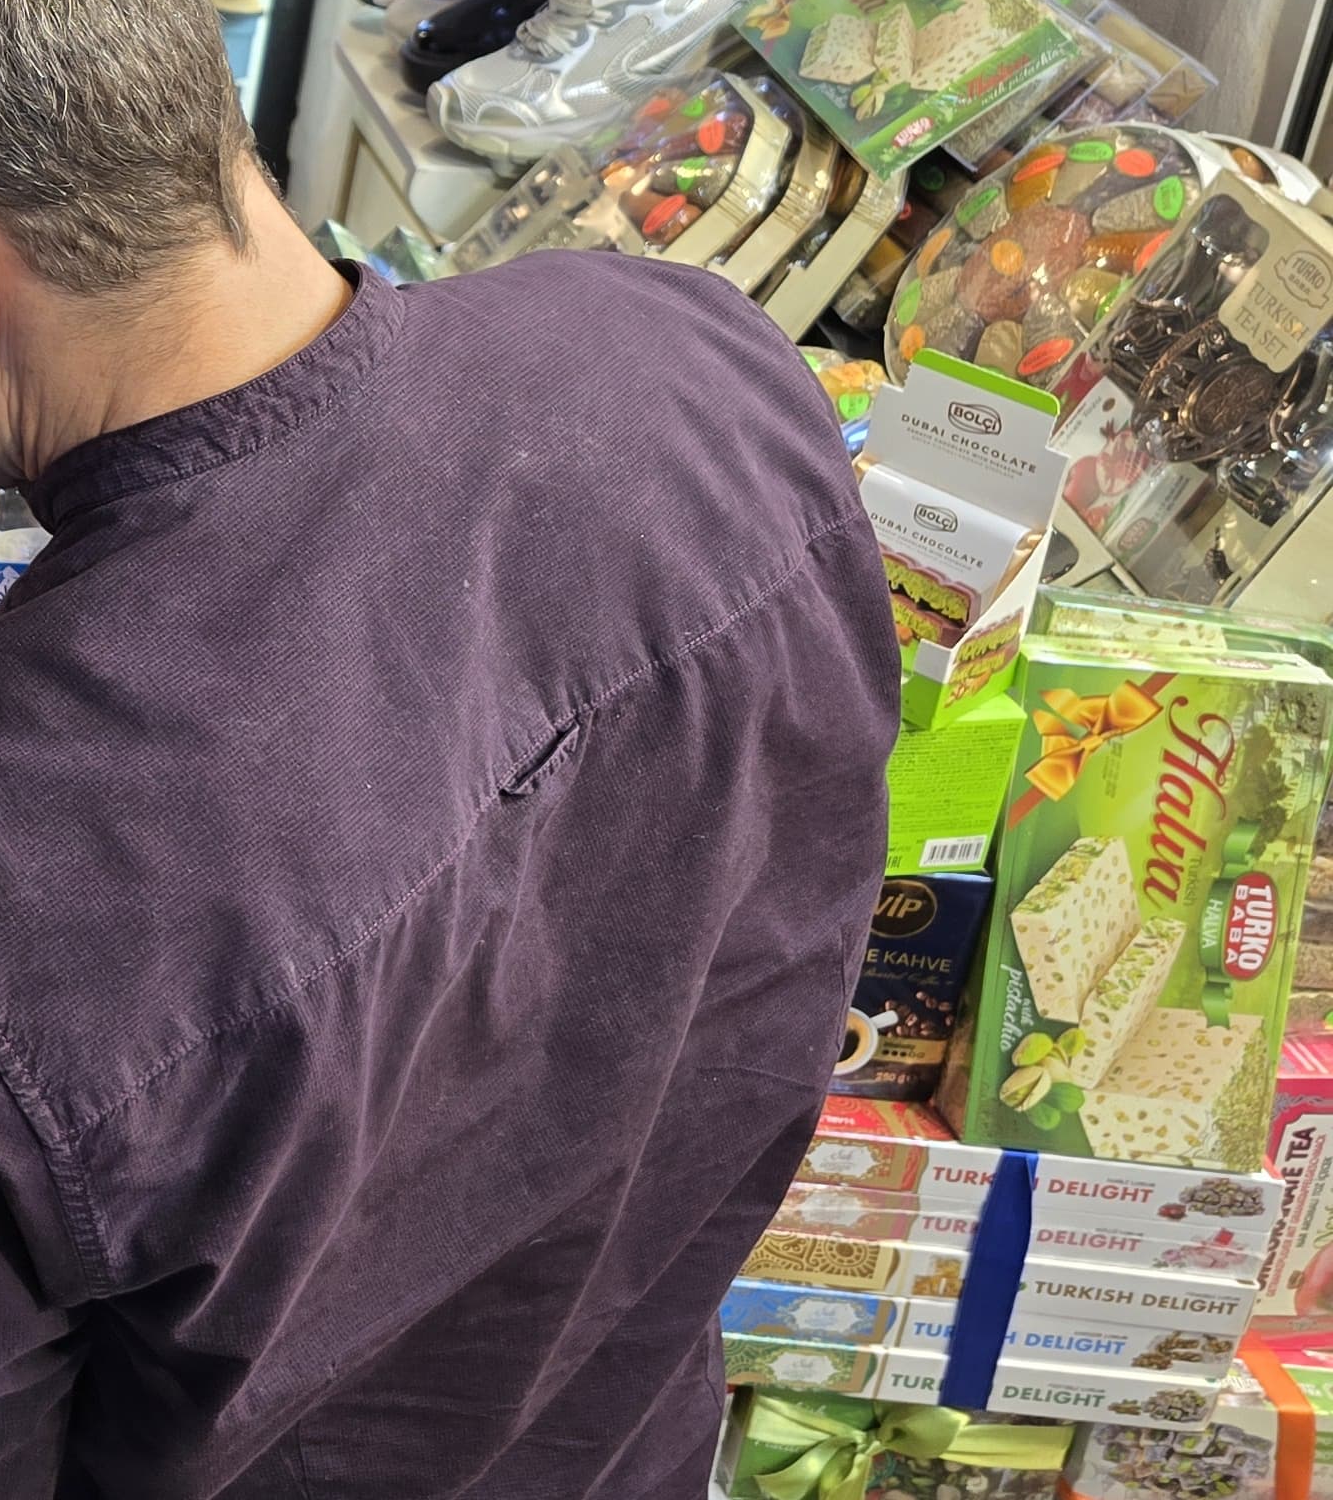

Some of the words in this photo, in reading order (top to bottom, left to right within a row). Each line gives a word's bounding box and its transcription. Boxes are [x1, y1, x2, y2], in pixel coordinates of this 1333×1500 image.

[1292, 257, 1326, 290] TURKO
[1234, 306, 1262, 337] TEA
[1259, 329, 1288, 359] SET
[1248, 281, 1310, 342] TURKISH
[901, 414, 945, 438] DUBAI
[951, 434, 1037, 474] CHOCOLATE
[870, 512, 907, 534] DUBAI
[912, 532, 984, 568] CHOCOLATE
[1143, 695, 1235, 912] Halva
[1185, 854, 1204, 907] Turkish
[1201, 896, 1223, 950] HALVA
[1225, 884, 1248, 965] BABA
[1237, 885, 1273, 972] TURKO
[884, 951, 952, 973] KAHVE
[1000, 963, 1023, 1052] pistachio
[1285, 1126, 1317, 1162] TEA
[1047, 1179, 1154, 1203] DELIGHT
[1036, 1228, 1142, 1252] DELIGHT
[1035, 1281, 1134, 1305] TURKISH
[1141, 1293, 1239, 1316] DELIGHT
[1025, 1333, 1126, 1355] DELIGHT
[1002, 1386, 1106, 1409] DELIGHT
